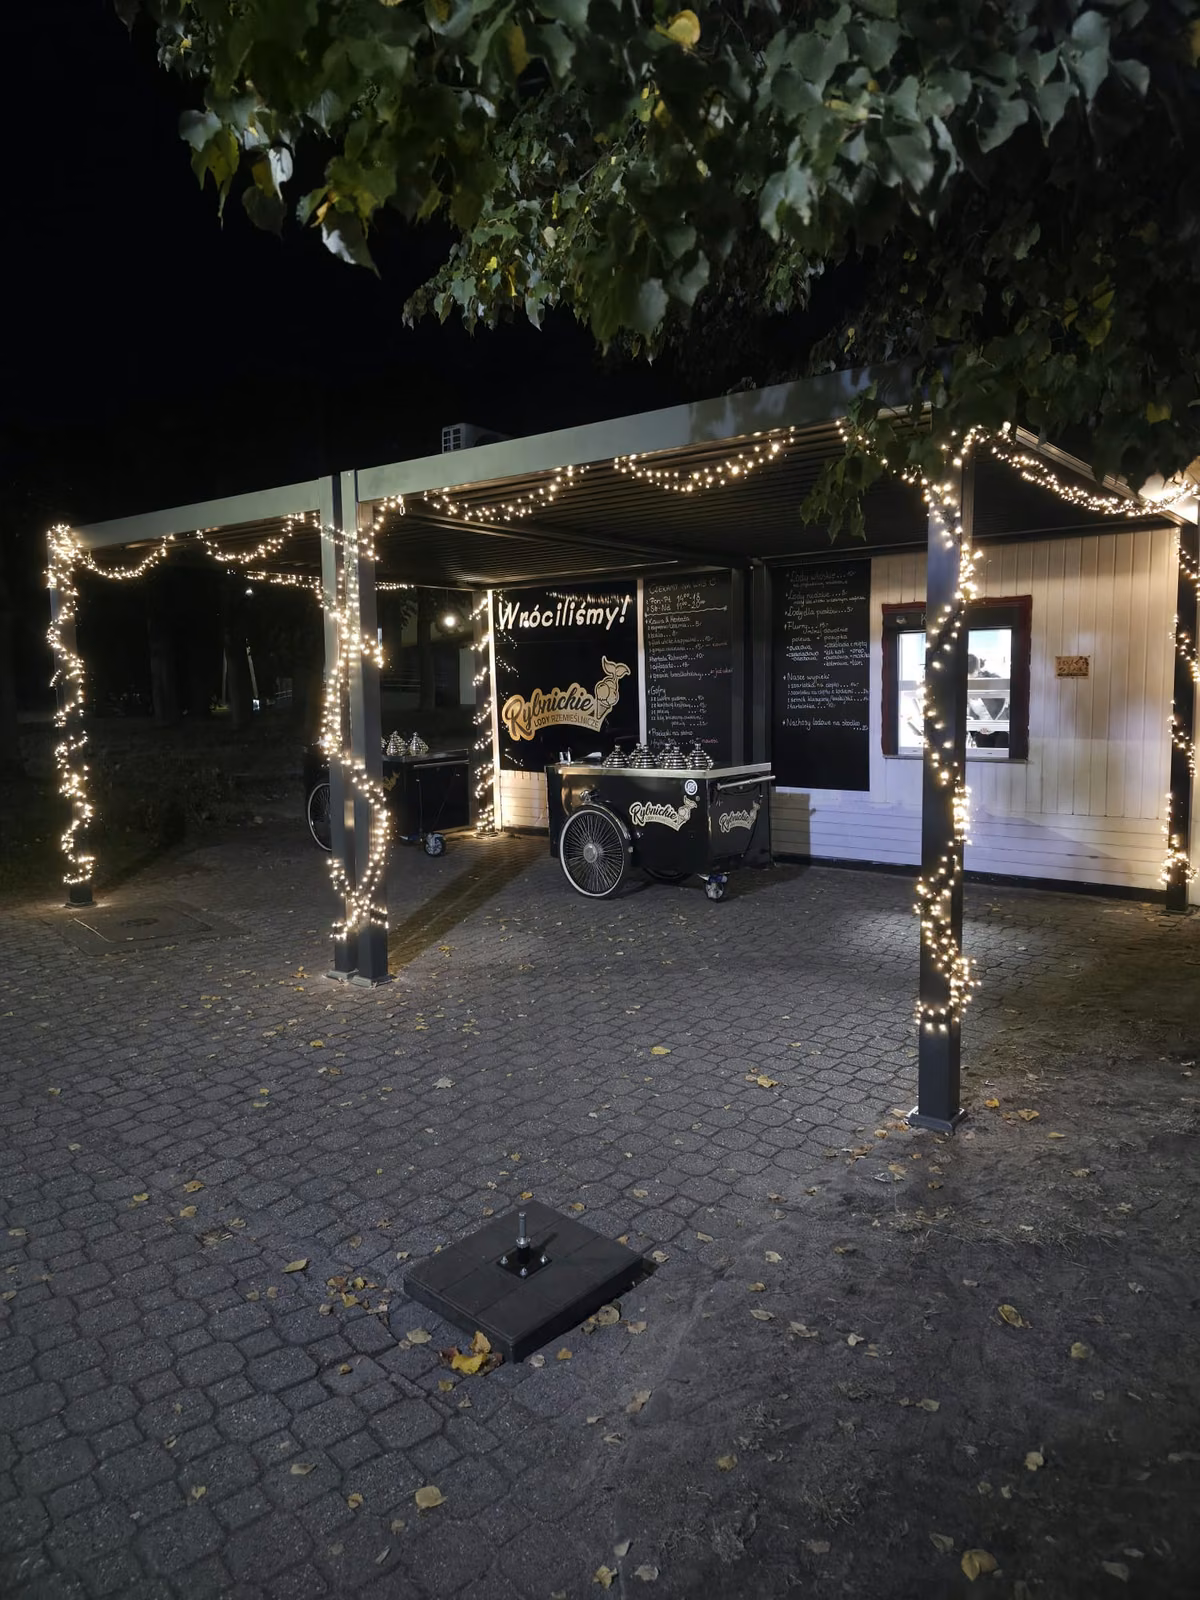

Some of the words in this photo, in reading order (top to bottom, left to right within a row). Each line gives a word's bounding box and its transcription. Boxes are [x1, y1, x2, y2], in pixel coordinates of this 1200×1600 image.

[498, 594, 629, 631] Wróciliśmy!
[504, 687, 594, 737] Rybnickie
[534, 717, 550, 727] LODY
[551, 713, 599, 728] RZEMIEŚLNICZE
[631, 802, 678, 825] Rybnickie
